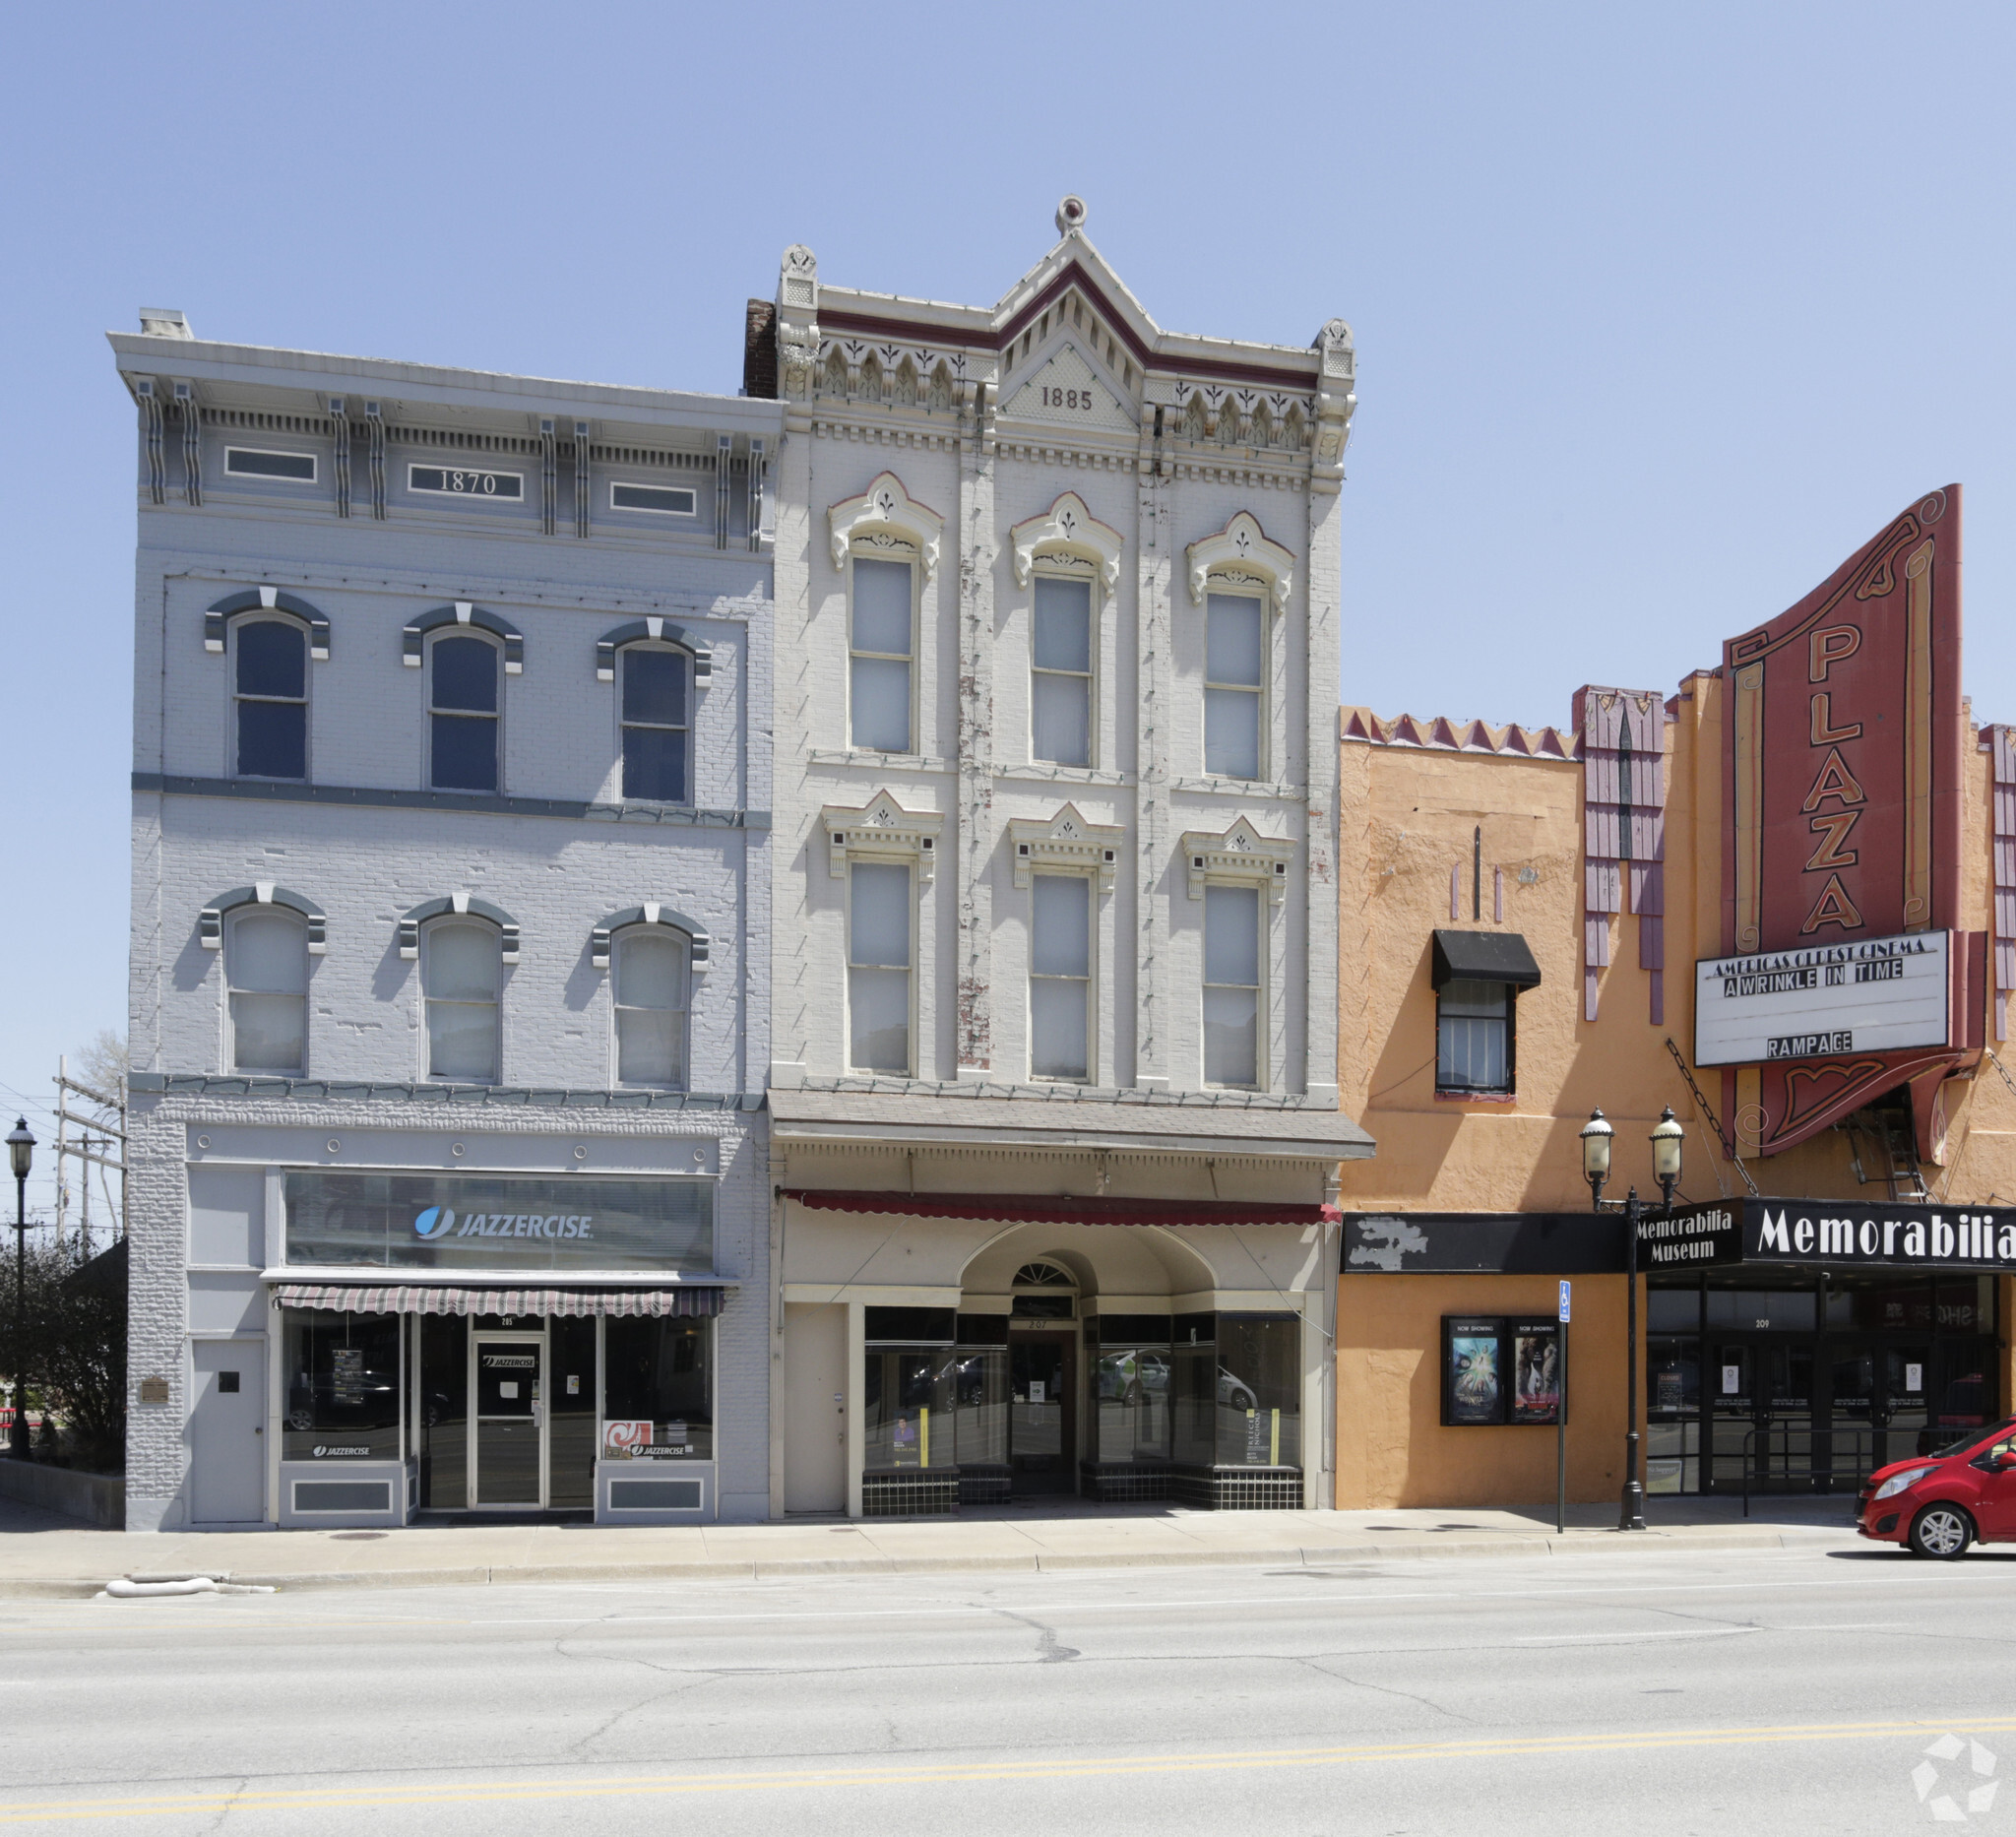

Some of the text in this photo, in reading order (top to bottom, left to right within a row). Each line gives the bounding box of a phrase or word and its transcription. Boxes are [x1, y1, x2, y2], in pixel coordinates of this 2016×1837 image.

[1042, 386, 1092, 411] 1885
[440, 471, 496, 494] 1870
[1799, 623, 1867, 935] PLAZA
[1713, 938, 1926, 978] AMERICAS OLDEST CINEMA
[1725, 959, 1903, 998] A WRINKLE IN TIME
[1767, 1032, 1852, 1057] RAMPAGE
[457, 1213, 594, 1239] JAZZERCISE
[1637, 1209, 1732, 1240] Memorabilia
[1758, 1208, 2016, 1260] Memorabilia
[1651, 1240, 1715, 1263] Museum
[501, 1317, 513, 1326] 205
[1029, 1320, 1047, 1329] 207
[1755, 1318, 1770, 1329] 209
[326, 1447, 370, 1456] JAZZERCISE
[643, 1446, 685, 1456] JAZZERCISE
